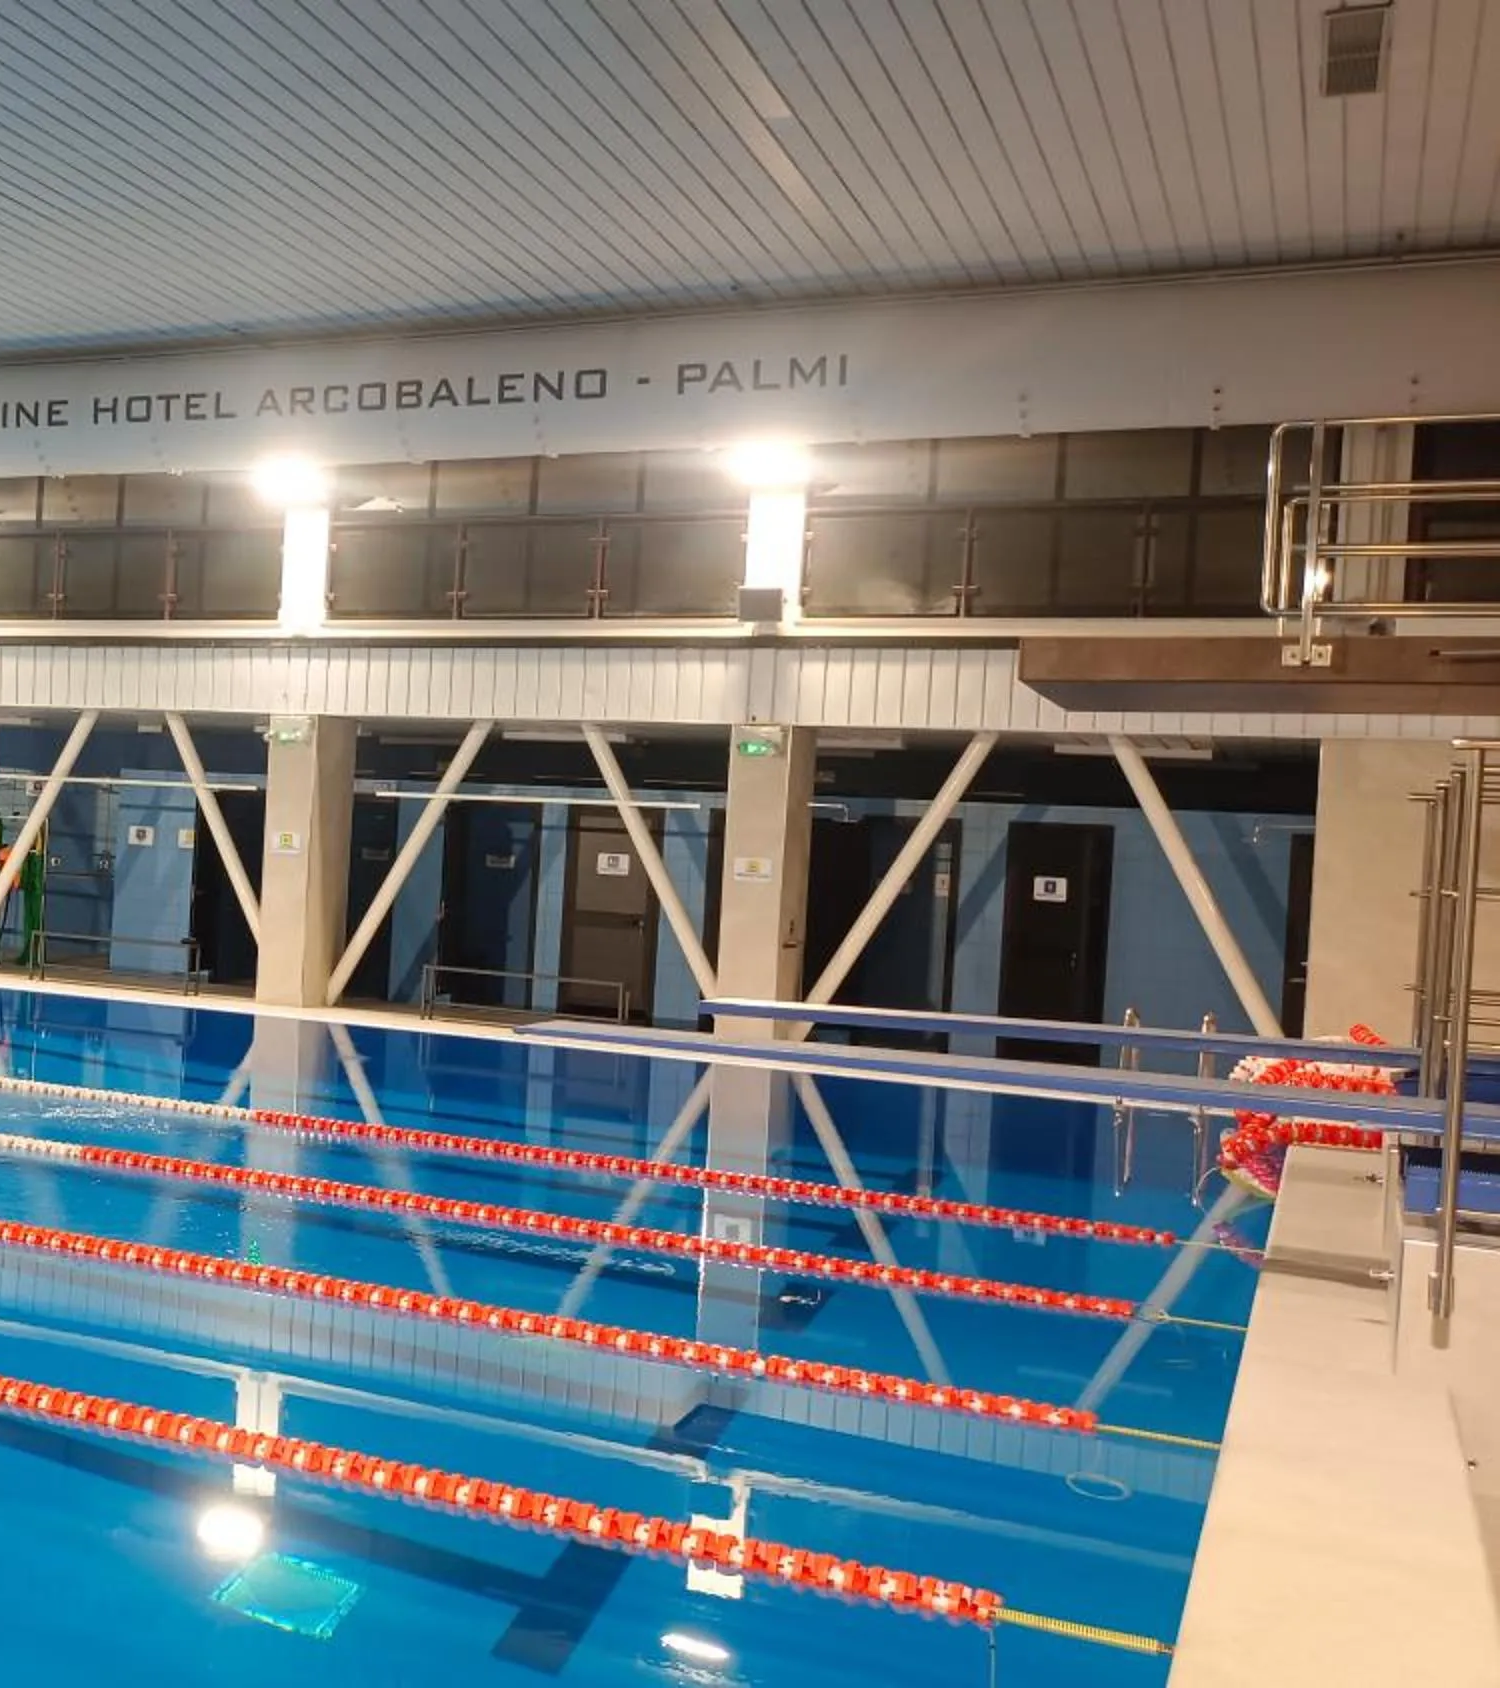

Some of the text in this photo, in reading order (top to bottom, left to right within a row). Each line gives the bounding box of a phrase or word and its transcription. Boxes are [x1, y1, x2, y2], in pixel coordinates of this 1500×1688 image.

[93, 391, 236, 425] HOTEL
[255, 368, 607, 417] ARCOBALENO
[677, 354, 848, 395] PALMI
